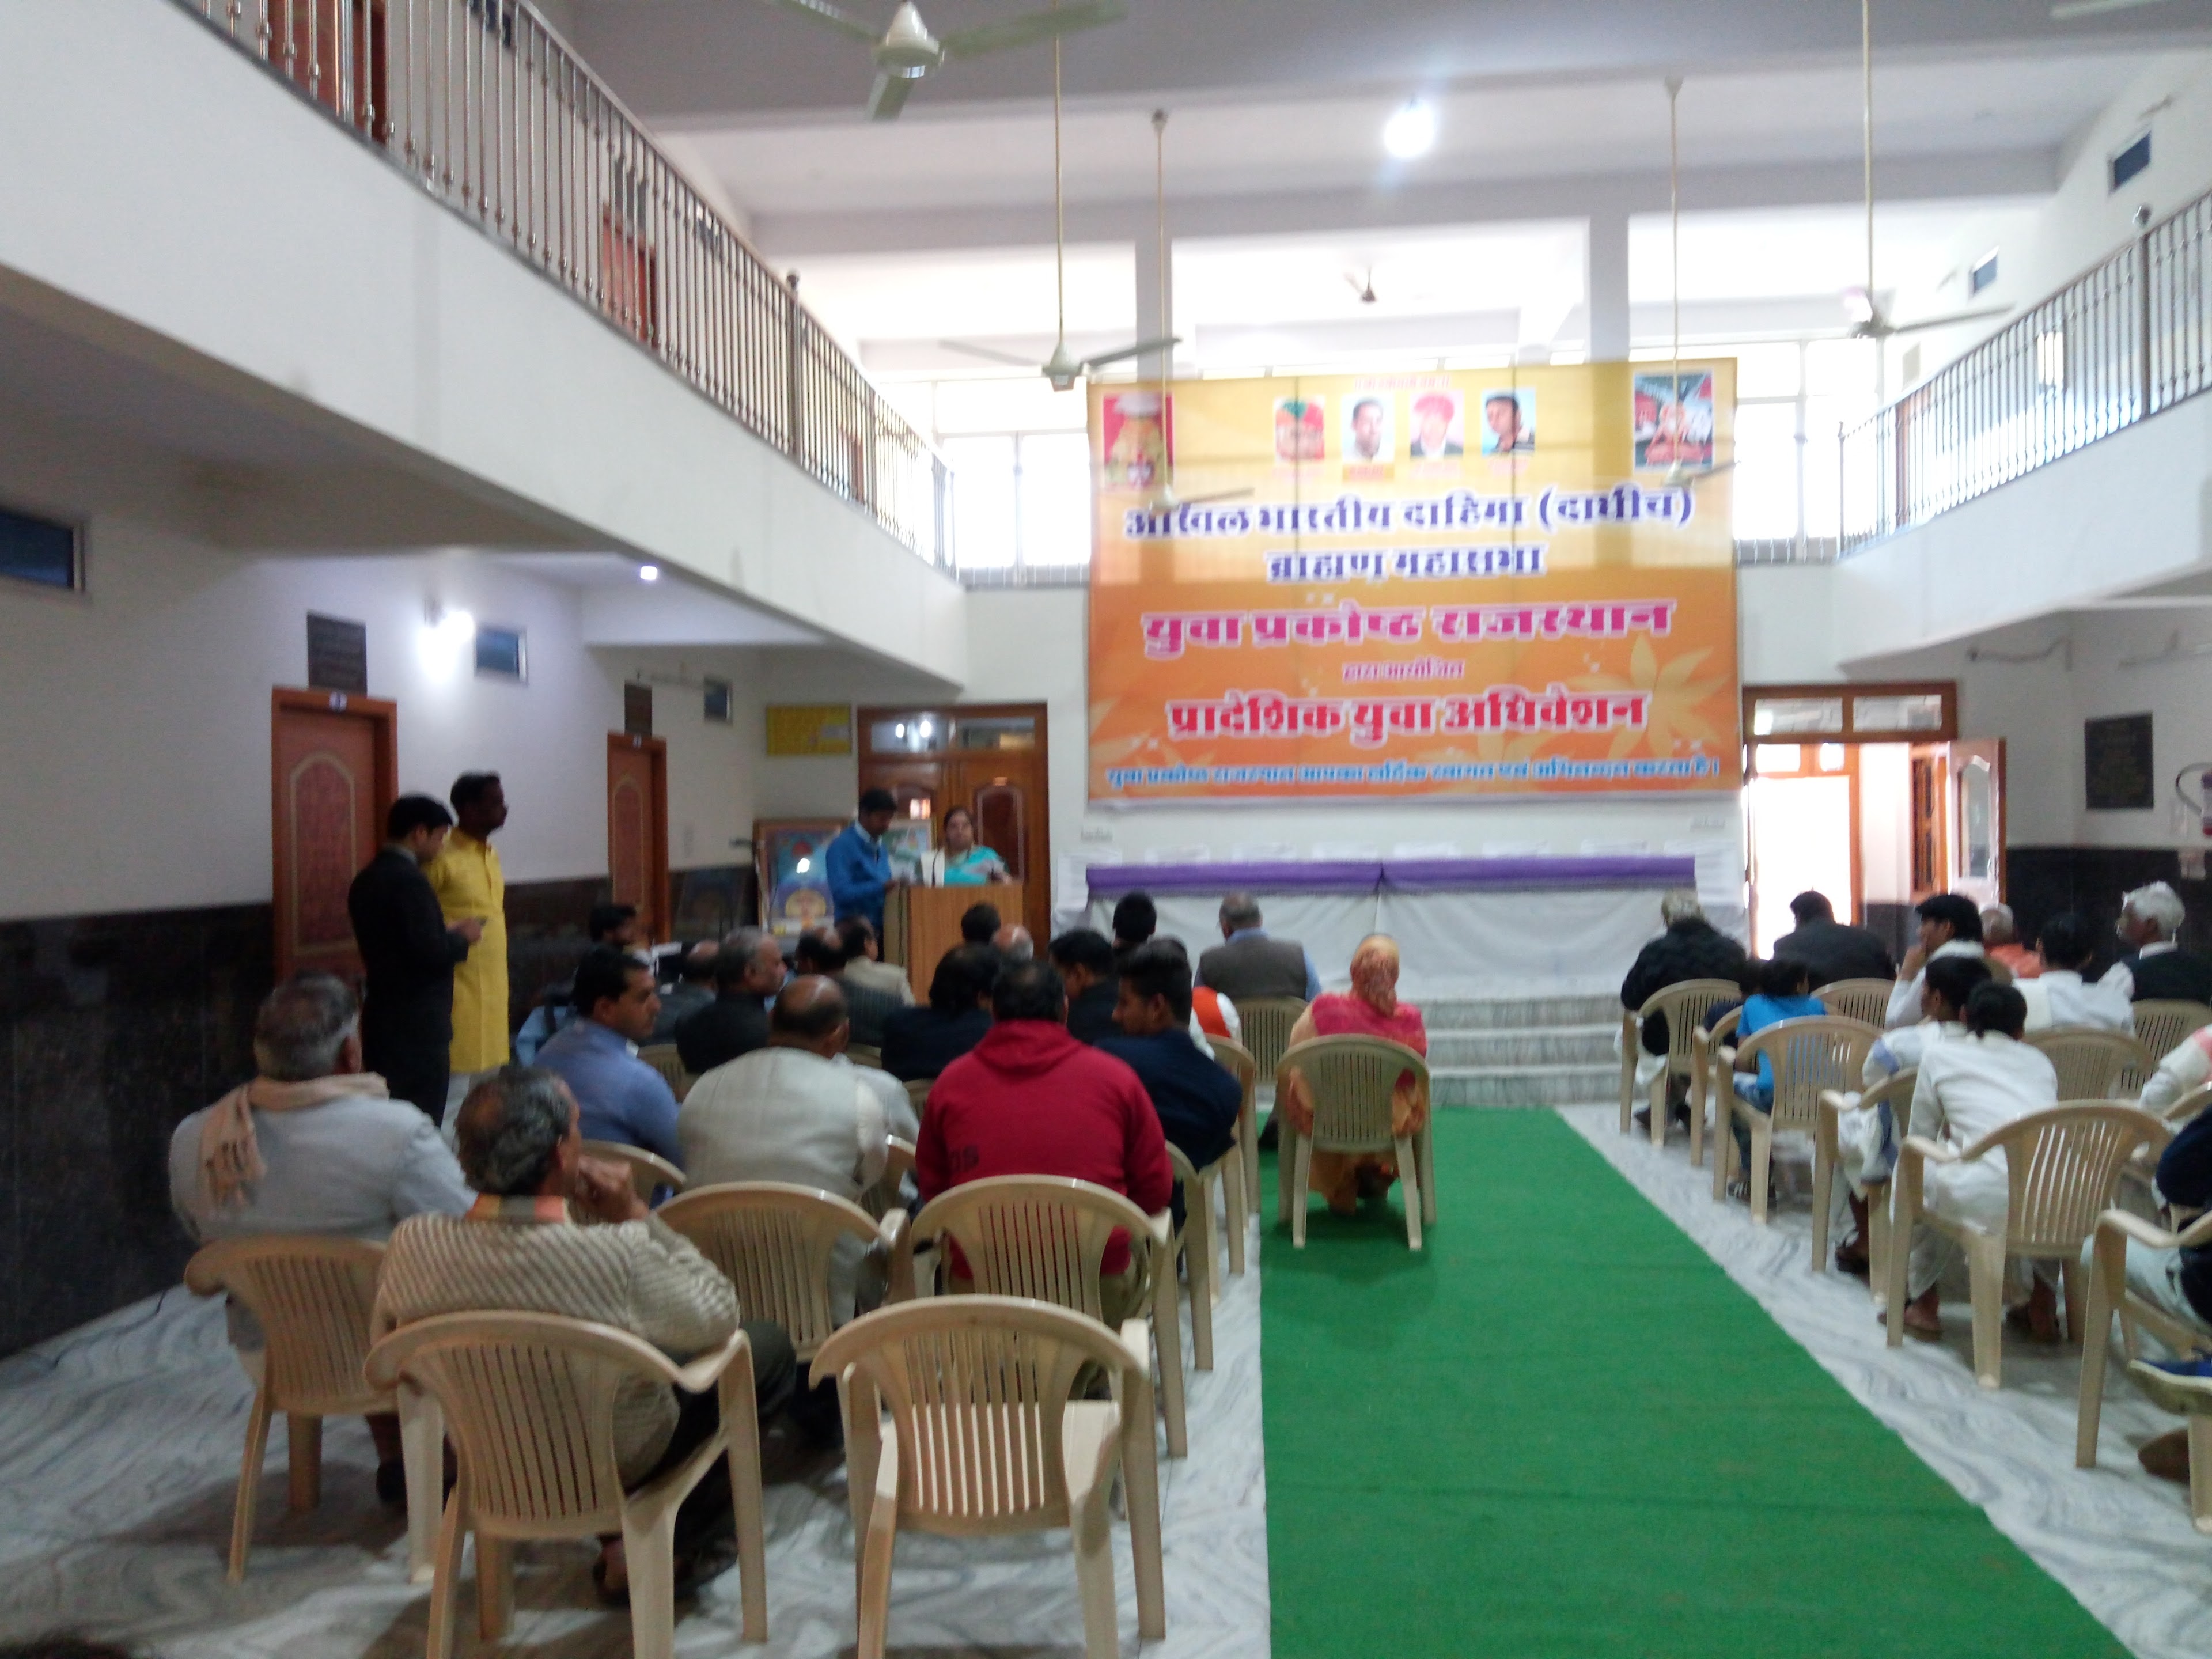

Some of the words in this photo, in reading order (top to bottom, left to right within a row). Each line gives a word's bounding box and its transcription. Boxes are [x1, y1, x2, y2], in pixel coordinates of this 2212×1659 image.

[1256, 492, 1399, 532] भारतीय
[1394, 545, 1550, 579] महासभा
[1142, 611, 1244, 659] युवा
[1430, 599, 1677, 642] राजस्थान
[1165, 690, 1346, 740] प्रादेशिक
[1348, 697, 1439, 749] युवा
[1439, 684, 1652, 734] अधिवेशन
